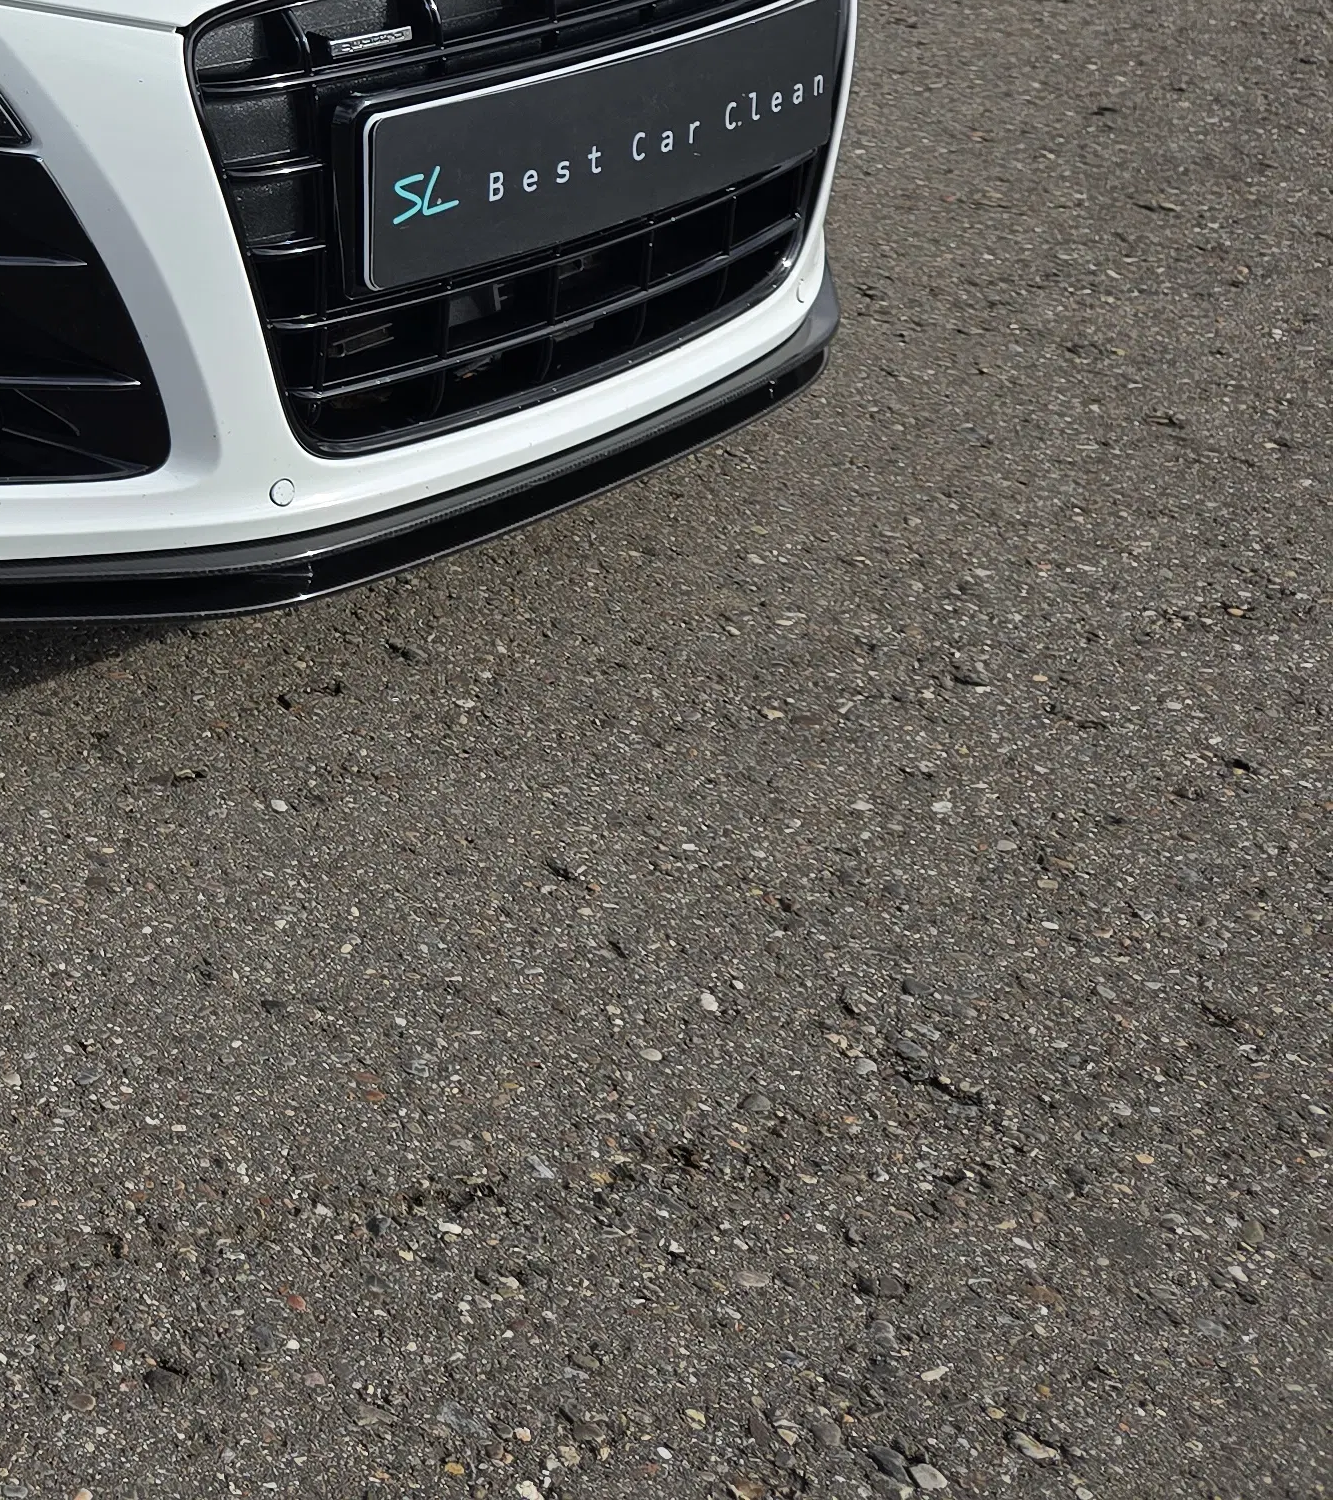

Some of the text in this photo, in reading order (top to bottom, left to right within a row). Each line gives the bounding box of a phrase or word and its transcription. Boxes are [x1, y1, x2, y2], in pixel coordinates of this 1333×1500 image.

[393, 74, 824, 225] SL Best Car Clean
